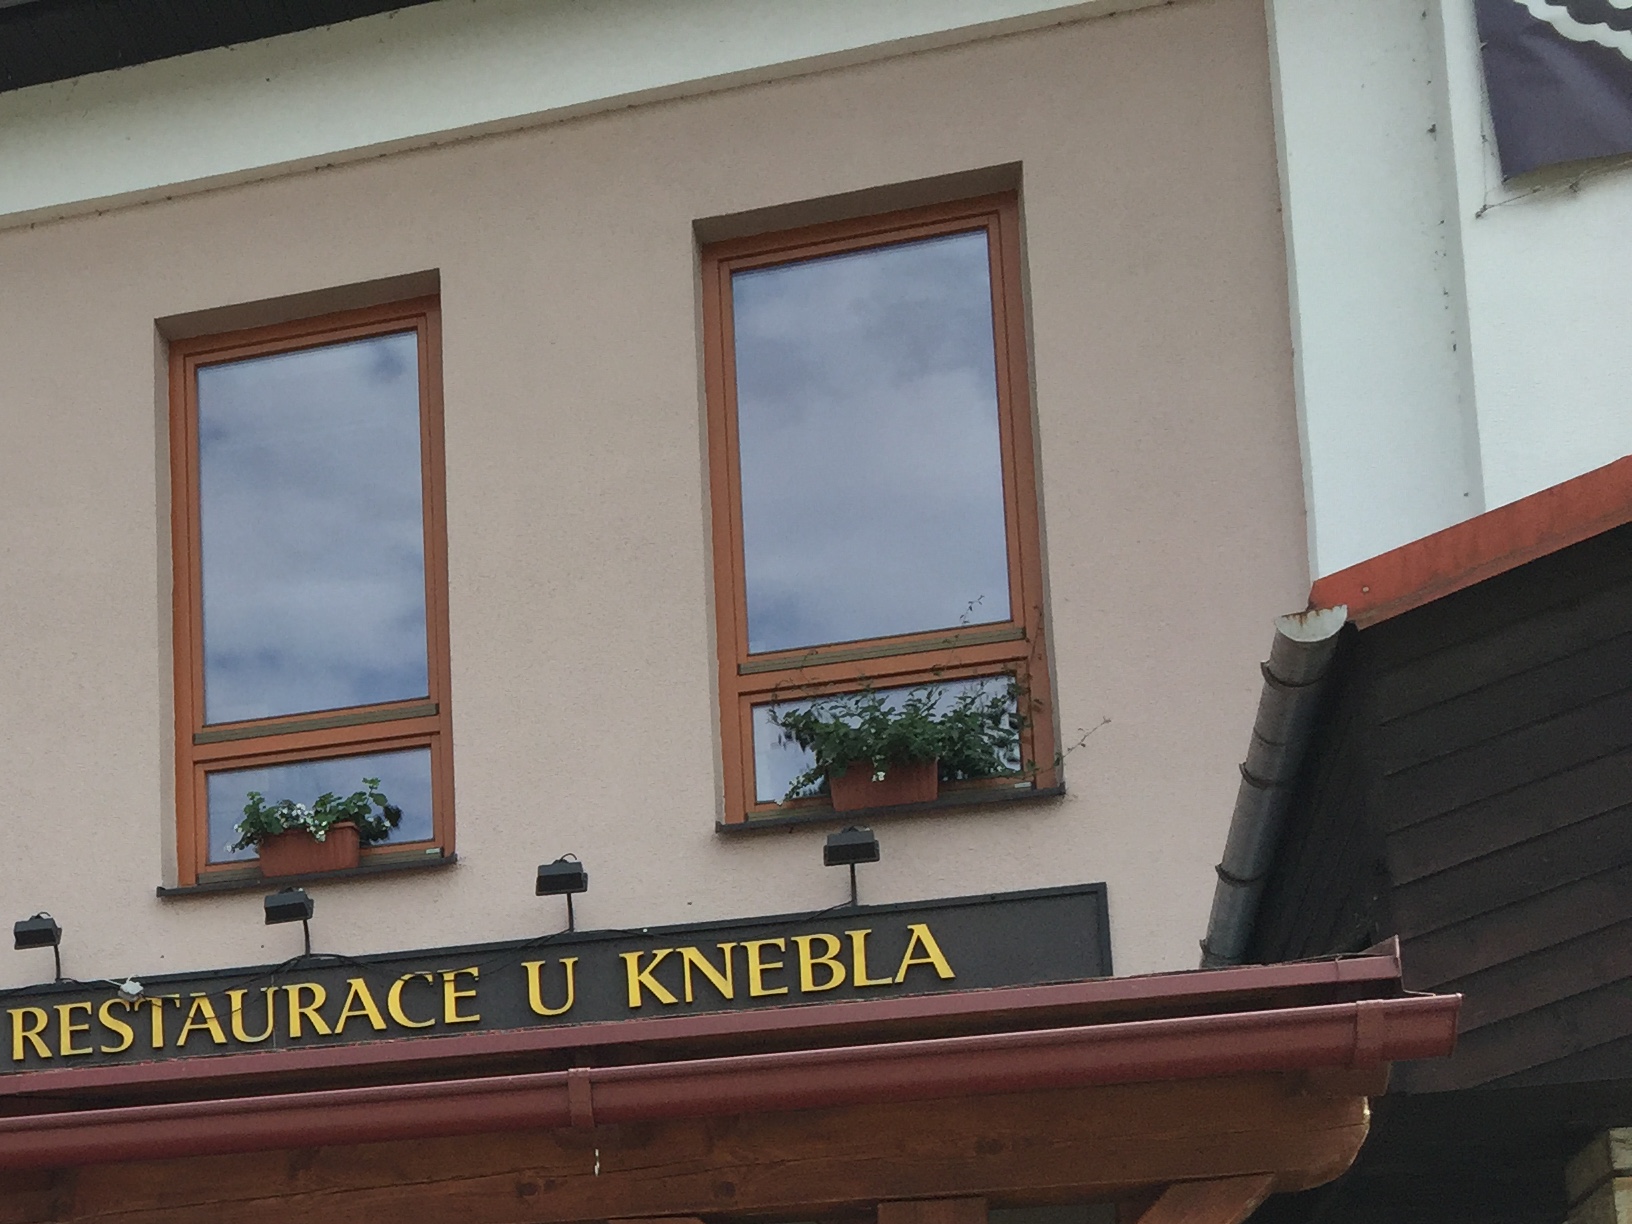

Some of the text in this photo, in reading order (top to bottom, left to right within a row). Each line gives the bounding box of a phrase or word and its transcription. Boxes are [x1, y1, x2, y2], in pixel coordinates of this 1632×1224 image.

[6, 966, 481, 1061] RESTAURACE
[520, 956, 578, 1017] U
[619, 922, 956, 1008] KNEBLA
